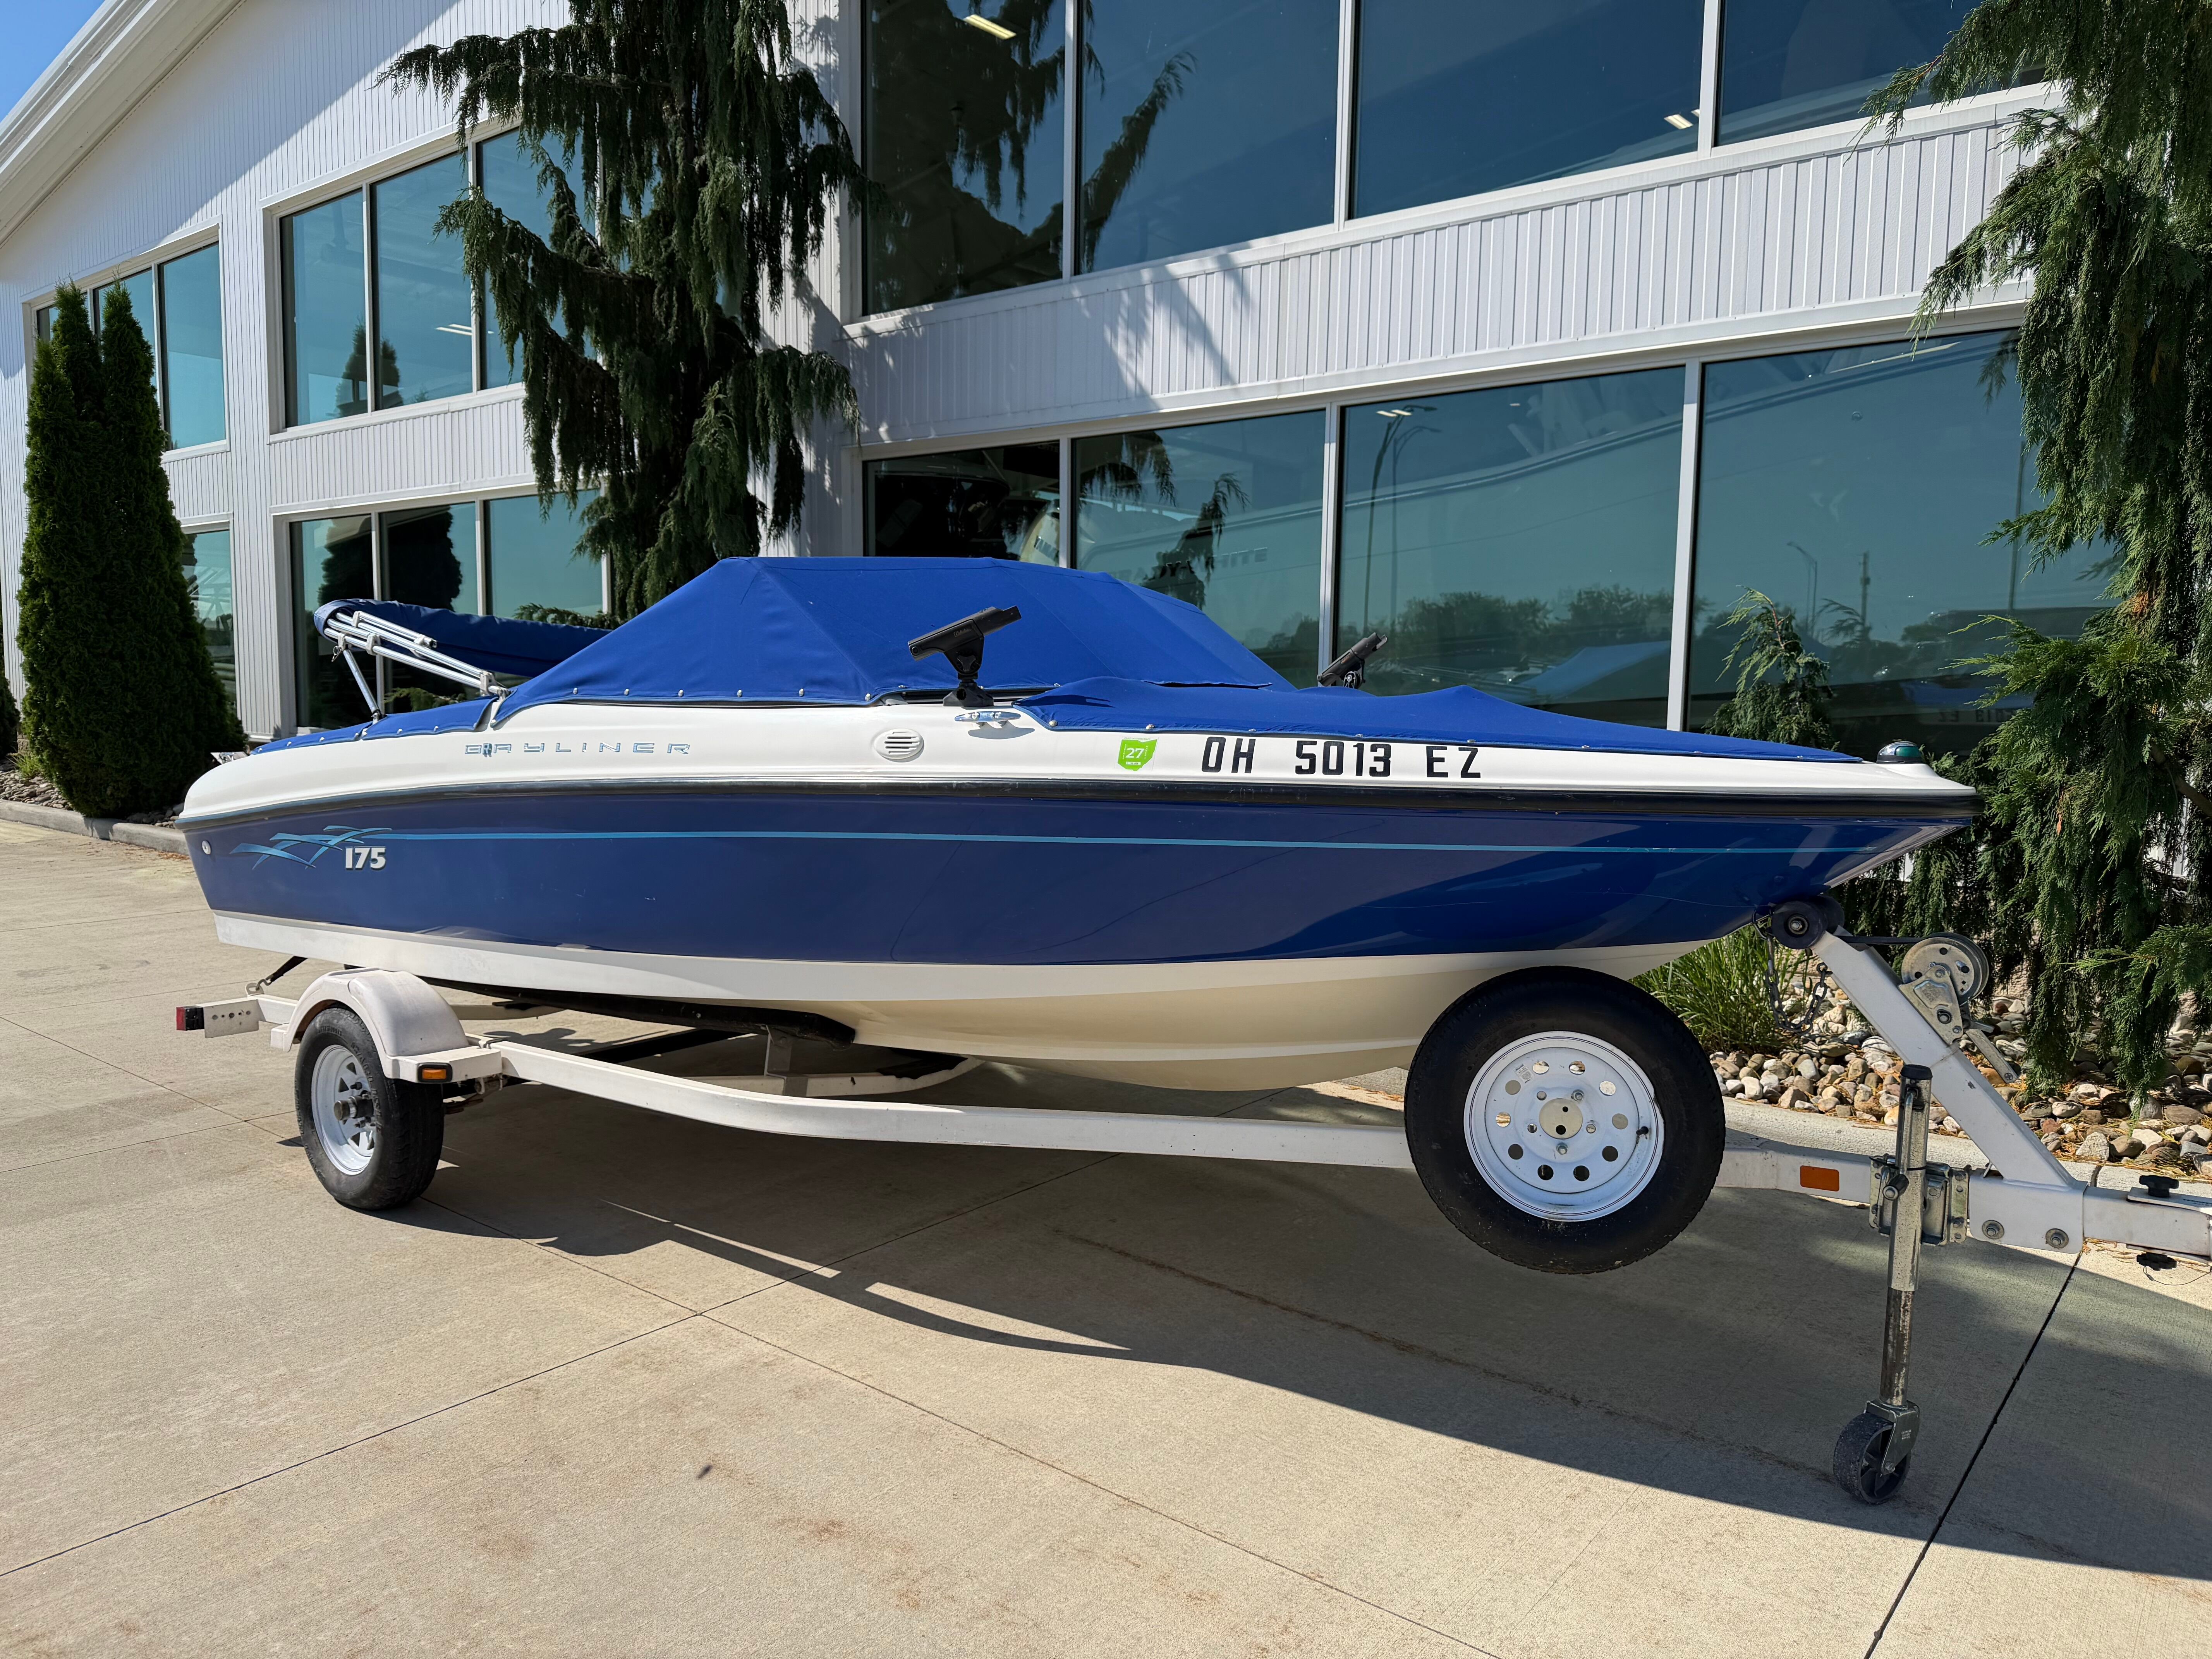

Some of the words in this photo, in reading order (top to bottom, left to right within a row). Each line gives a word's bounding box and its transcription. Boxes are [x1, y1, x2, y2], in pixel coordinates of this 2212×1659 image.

[1125, 747, 1145, 758] 27
[1201, 737, 1256, 774] OH
[1295, 740, 1391, 777] 5013
[1426, 746, 1481, 778] EZ
[345, 847, 386, 870] 175
